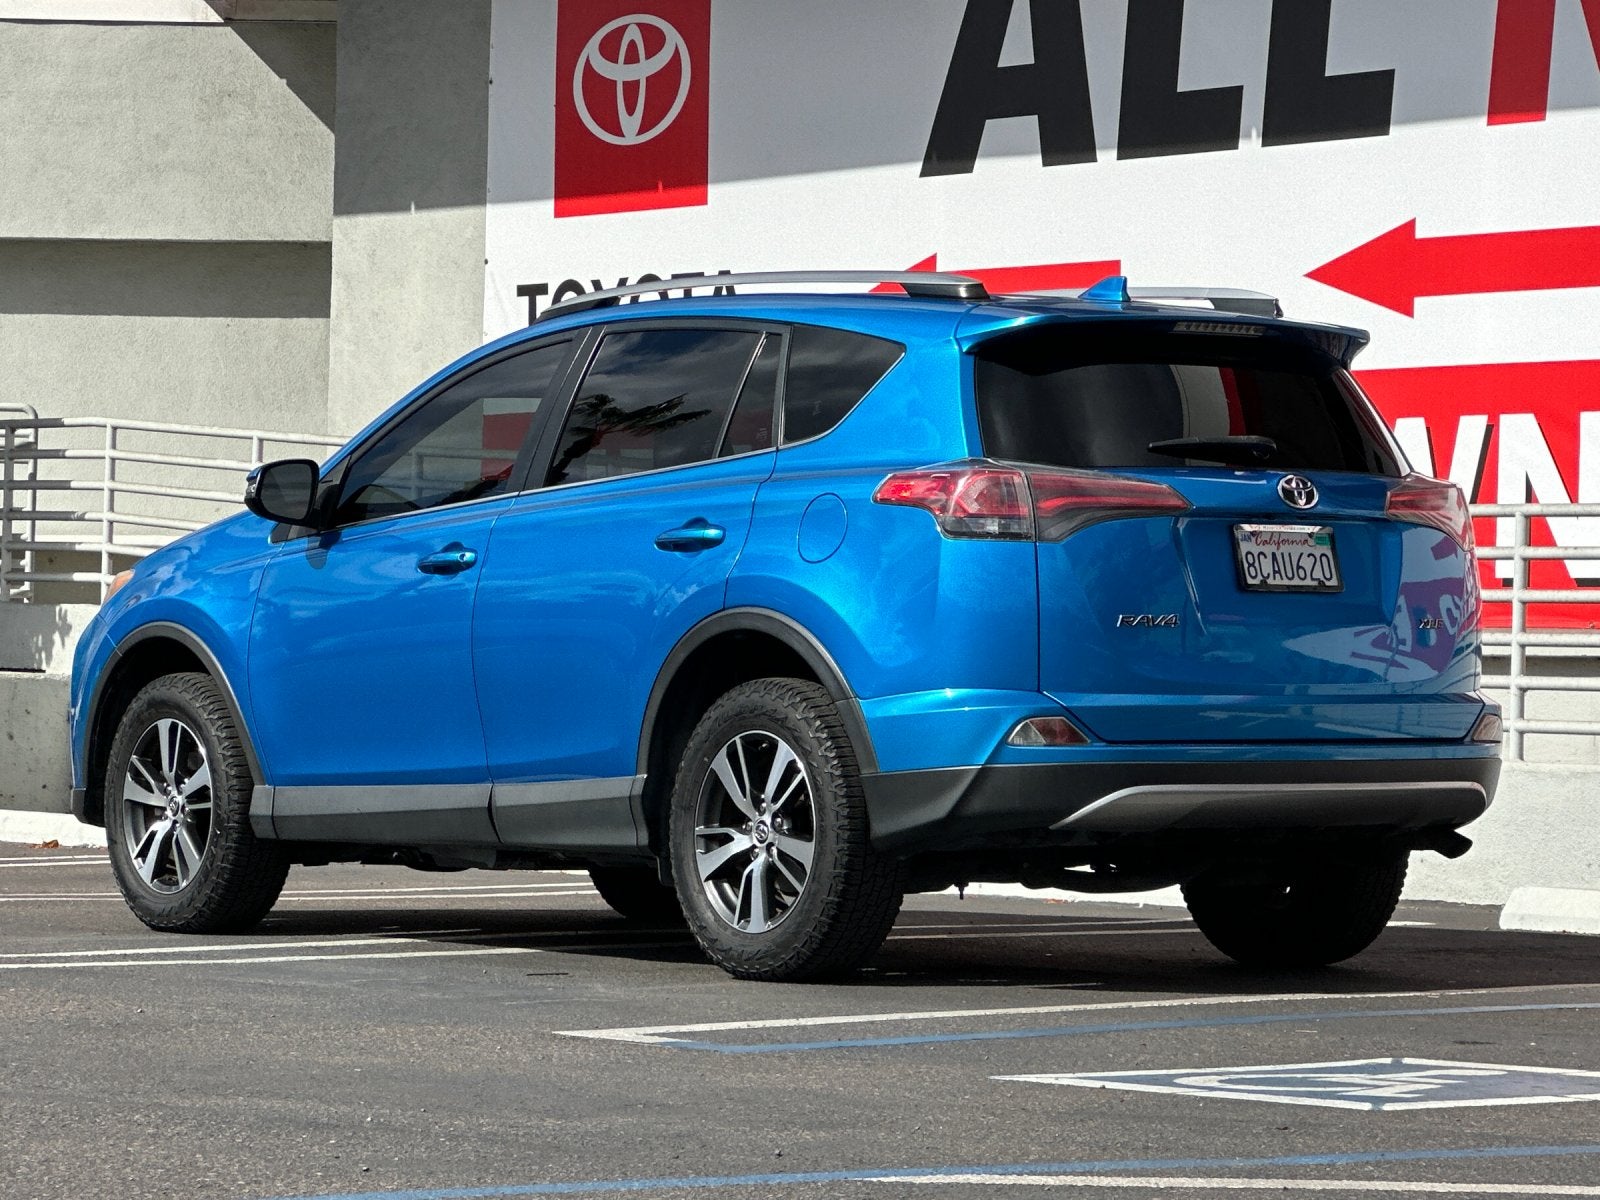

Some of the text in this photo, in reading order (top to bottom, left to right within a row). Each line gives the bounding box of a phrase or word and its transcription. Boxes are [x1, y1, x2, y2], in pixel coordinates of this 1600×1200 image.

[919, 0, 1395, 177] ALL
[1254, 531, 1317, 551] California
[1245, 550, 1333, 581] 8CAU620
[1116, 613, 1180, 628] RAV4
